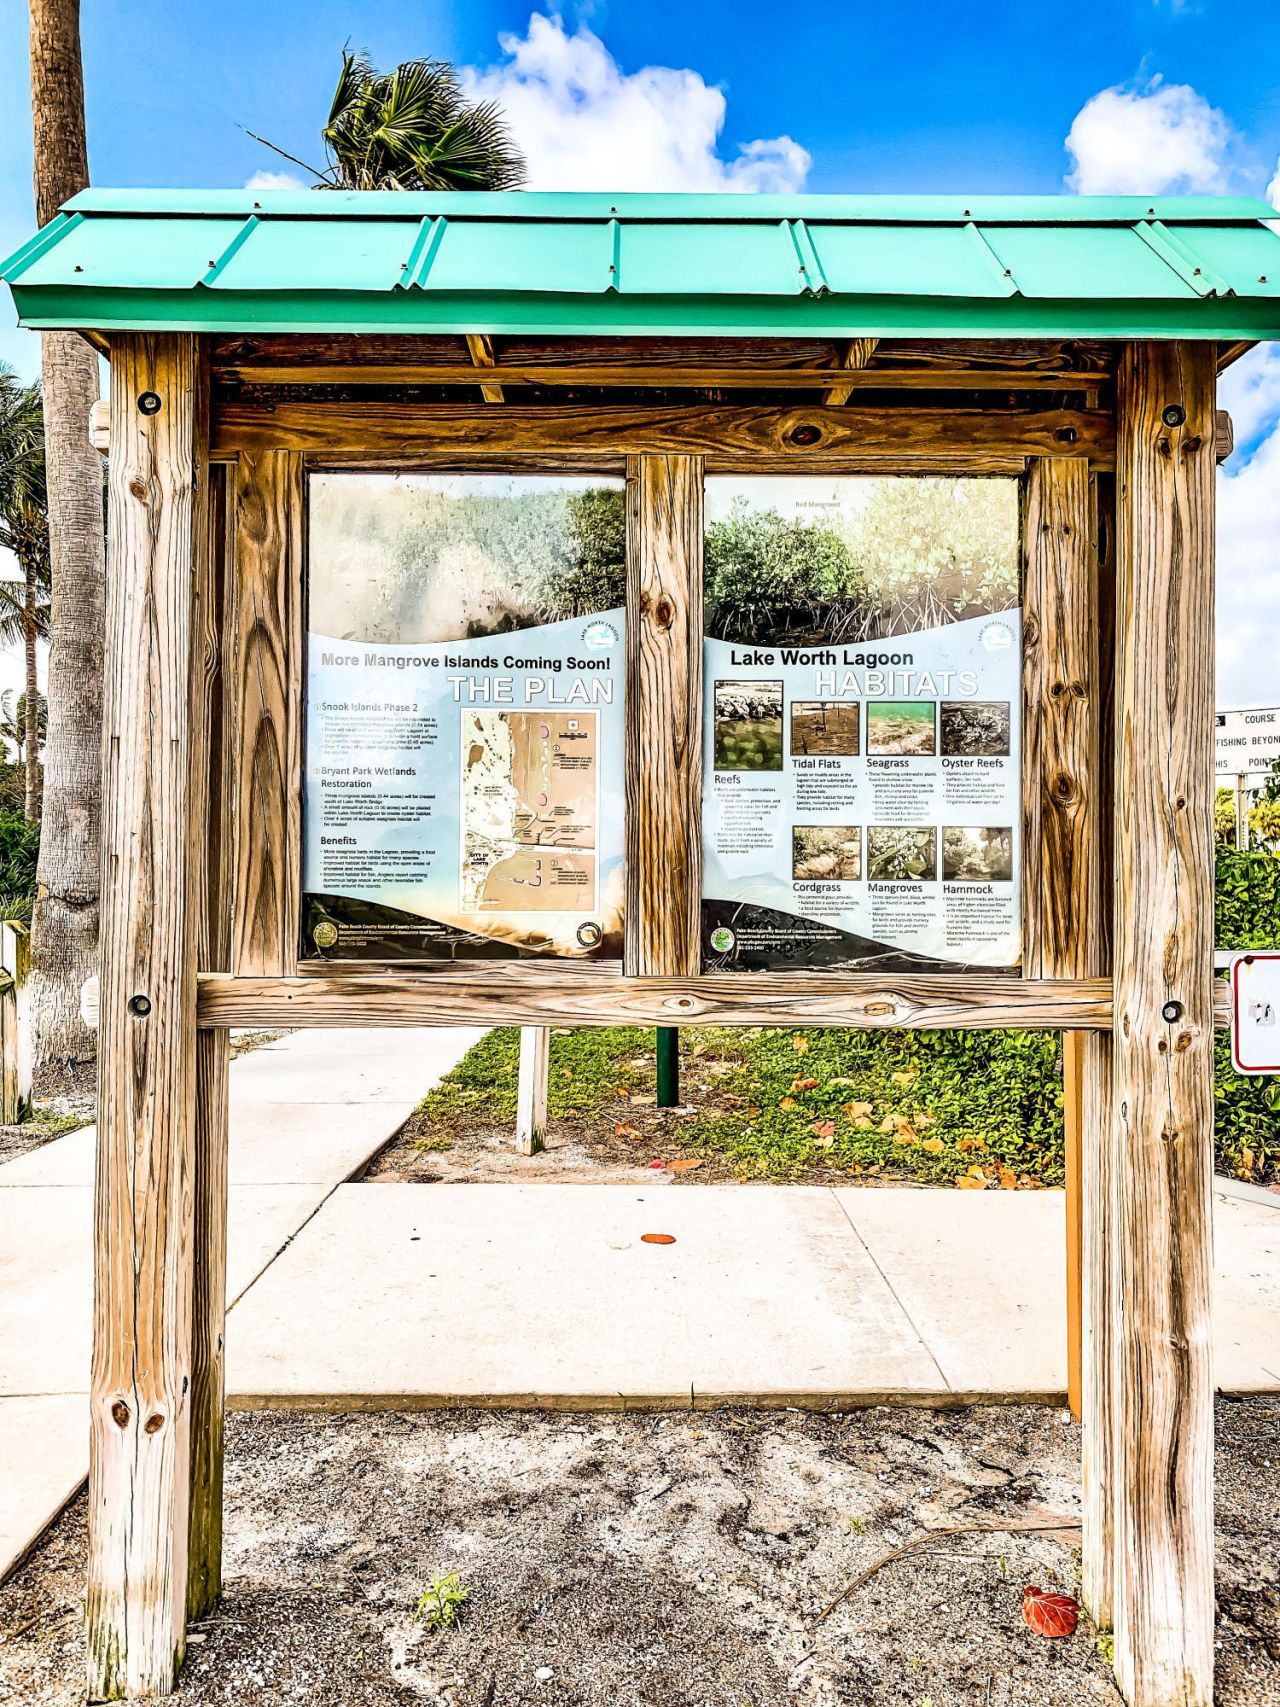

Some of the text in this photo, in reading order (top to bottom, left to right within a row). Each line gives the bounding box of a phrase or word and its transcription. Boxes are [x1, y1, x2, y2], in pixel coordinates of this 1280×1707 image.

[321, 653, 610, 672] More Mangrove Islands Coming Soon!
[731, 650, 914, 669] Lake Worth Lagoon
[815, 670, 978, 696] HABITATS
[448, 676, 614, 704] THE PLAN
[322, 703, 348, 711] Snook
[352, 703, 381, 711] Islands
[1245, 714, 1276, 724] COURSE
[1216, 736, 1280, 747] FISHING BEYON
[792, 759, 841, 768] Tidal Flats
[867, 758, 910, 769] Seagrass
[942, 758, 1004, 769] Oyster Reefs
[322, 767, 416, 776] Bryant Park Wetlands
[321, 780, 372, 788] Restoration
[714, 775, 741, 784] Reefs
[320, 836, 357, 845] Benefits
[793, 882, 841, 893] Cordgrass
[868, 883, 923, 894] Mangroves
[943, 885, 993, 894] Hammock
